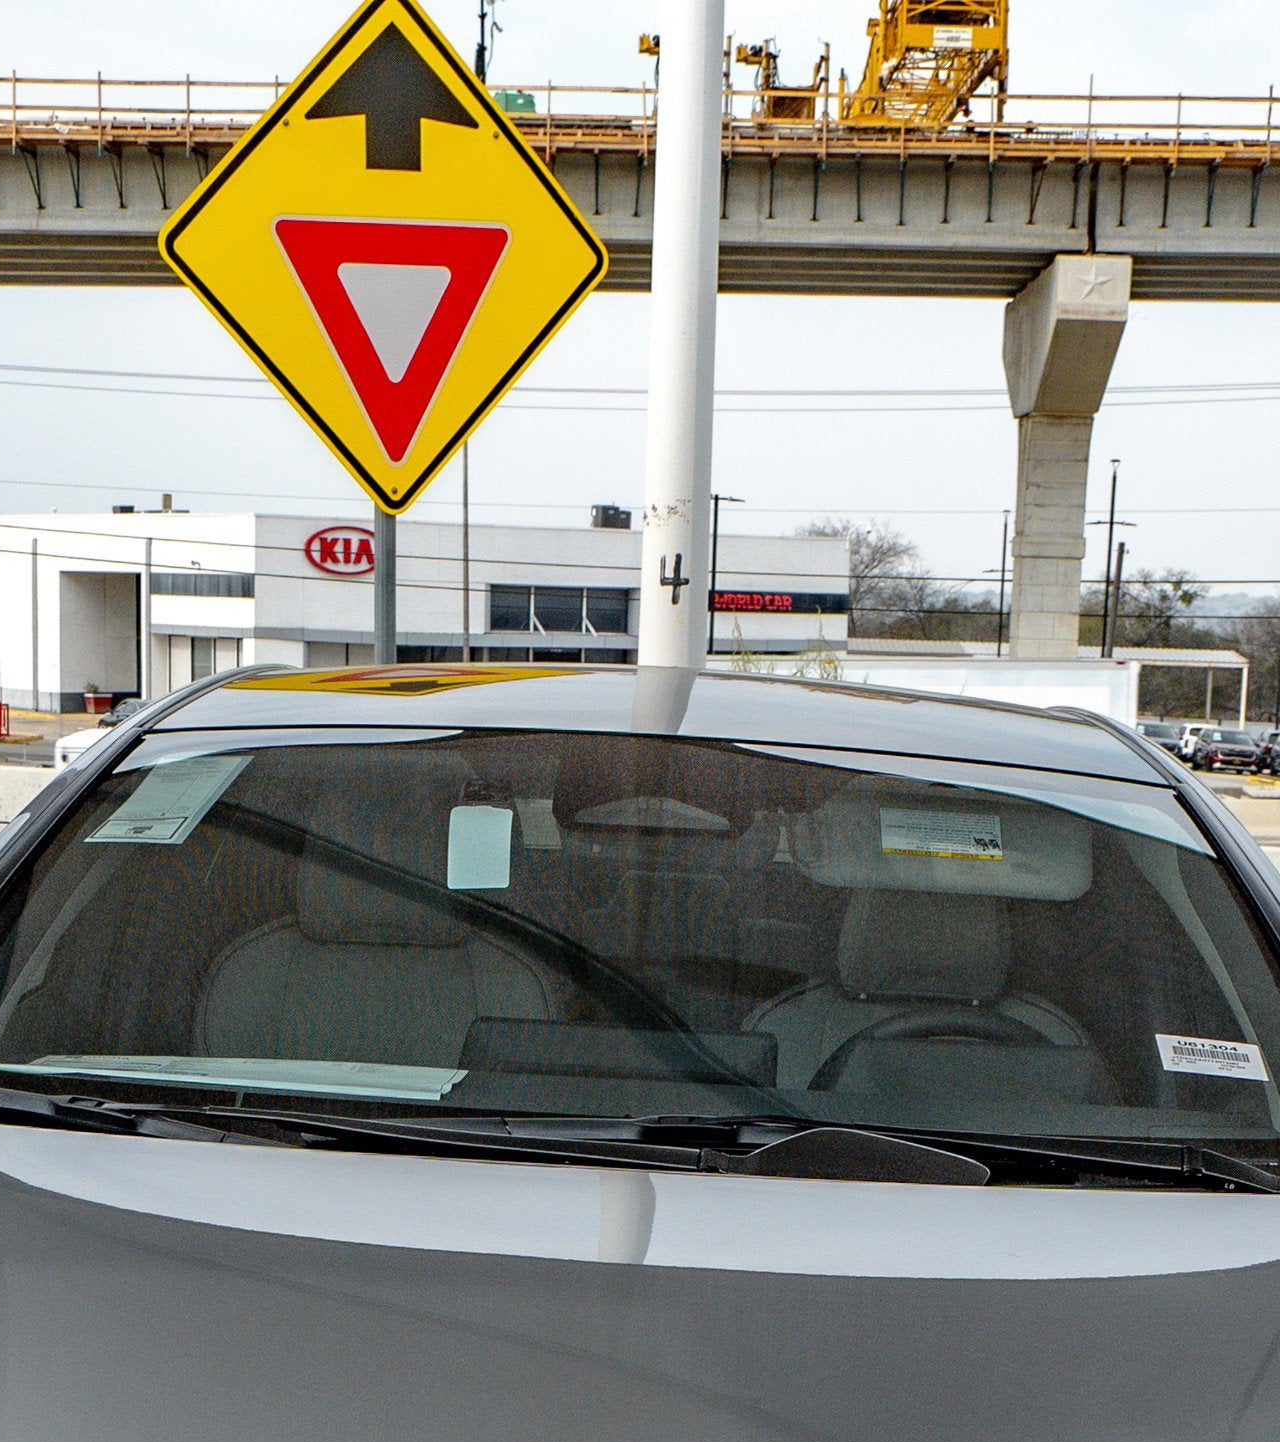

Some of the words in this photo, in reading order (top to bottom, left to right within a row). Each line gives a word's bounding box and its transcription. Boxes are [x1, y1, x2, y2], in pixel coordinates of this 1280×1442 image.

[319, 537, 374, 565] KIA
[660, 553, 689, 605] 4
[713, 592, 763, 609] WORLD
[764, 594, 793, 611] CAR
